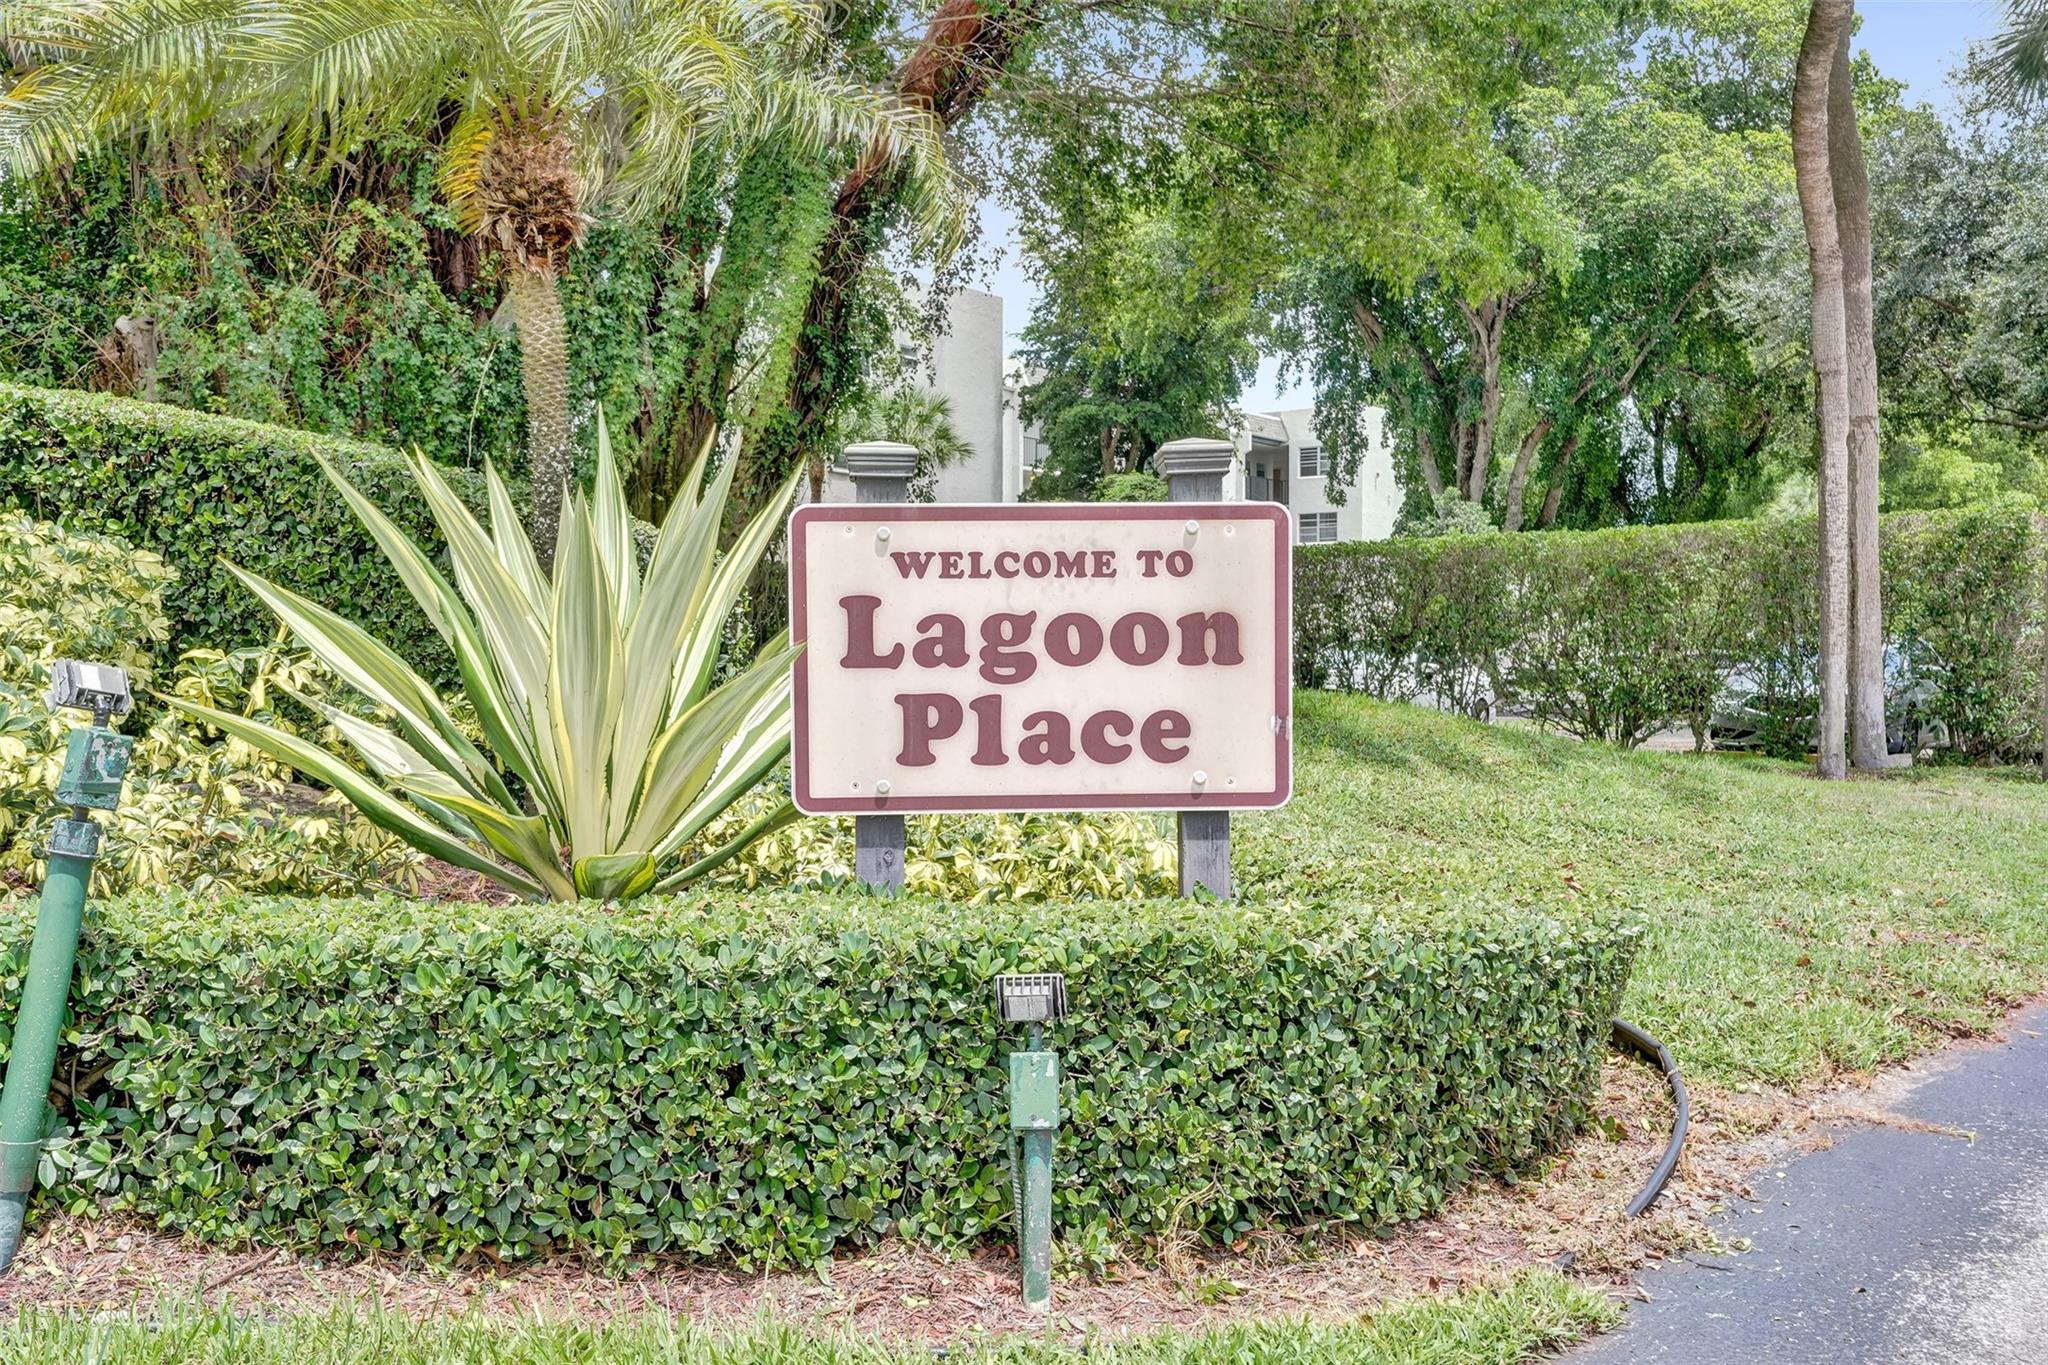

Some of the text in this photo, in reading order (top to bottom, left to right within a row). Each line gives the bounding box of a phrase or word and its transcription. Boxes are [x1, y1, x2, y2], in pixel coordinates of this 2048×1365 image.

[890, 549, 1194, 580] WELCOME TO
[838, 594, 1245, 685] Lagoon
[893, 692, 1192, 768] Place
